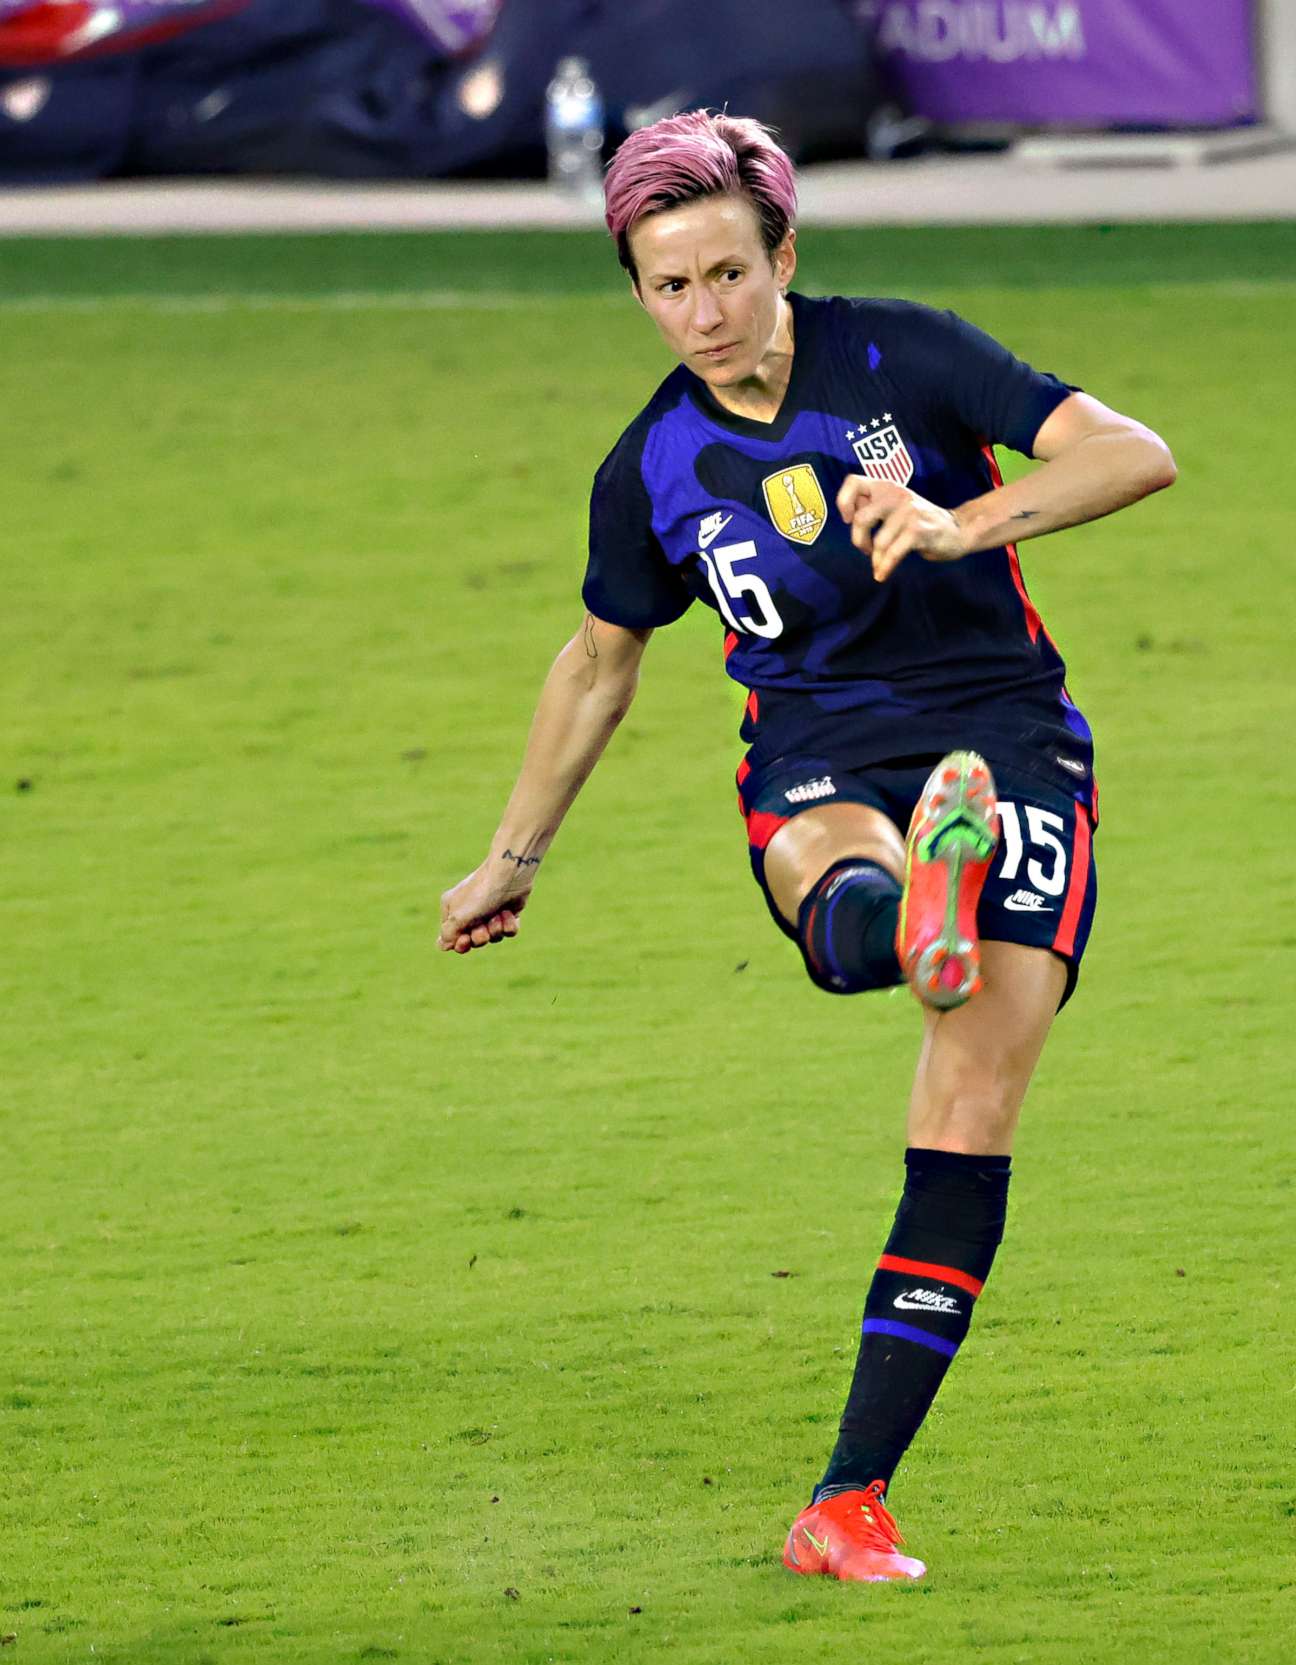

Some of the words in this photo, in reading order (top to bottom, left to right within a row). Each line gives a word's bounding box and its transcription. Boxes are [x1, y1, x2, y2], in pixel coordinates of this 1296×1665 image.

[857, 0, 1087, 63] ADIUM
[857, 430, 899, 460] USA
[699, 540, 783, 639] 15
[995, 802, 1066, 896] 15
[1012, 889, 1045, 907] NIKE
[907, 1288, 957, 1308] NIKE
